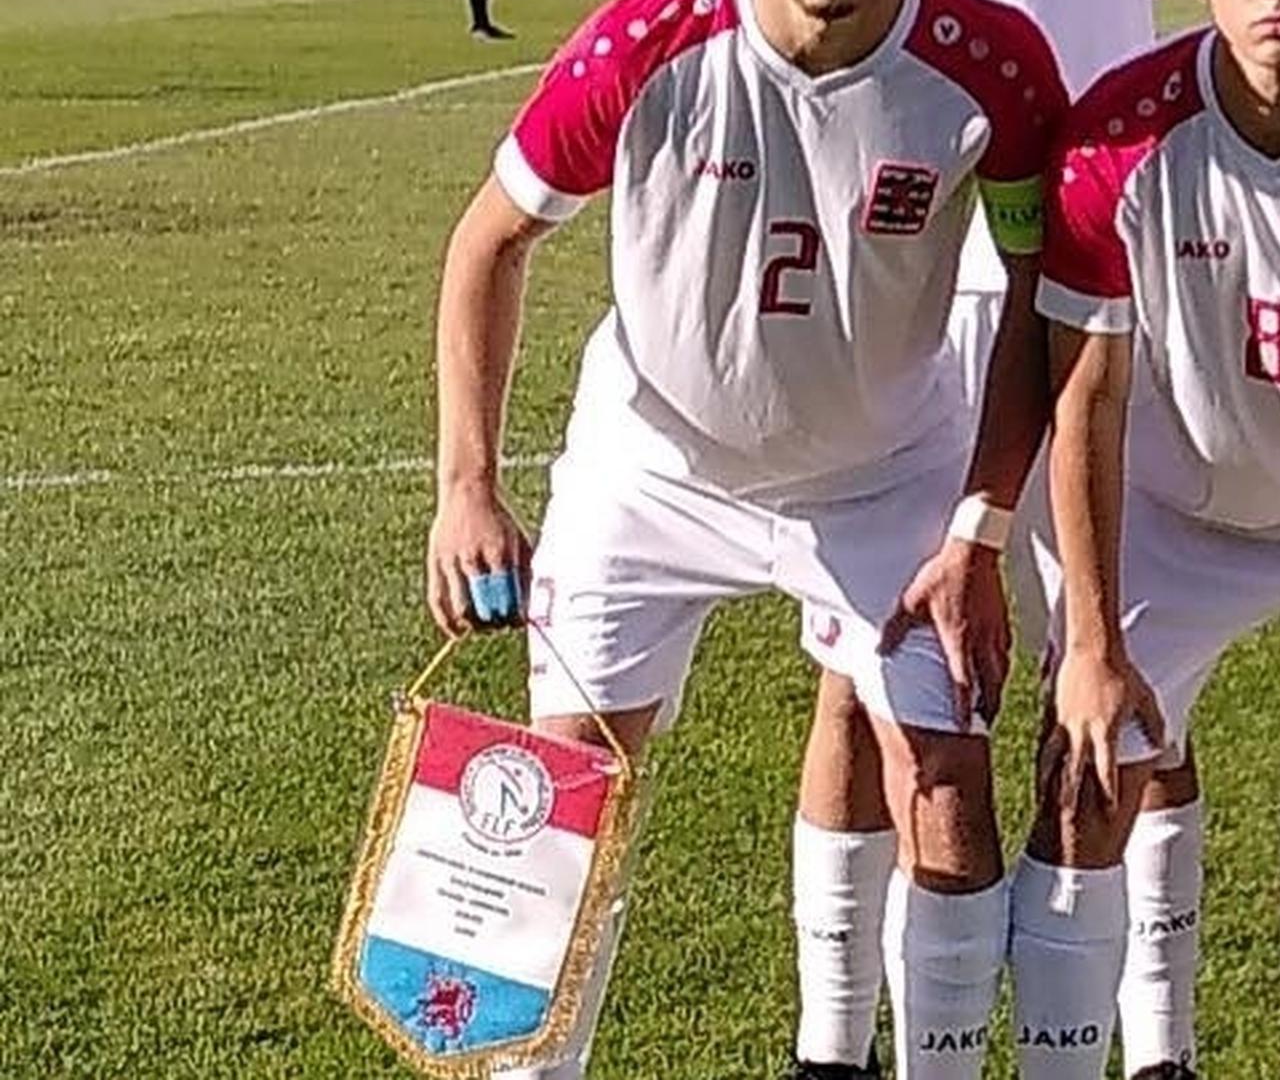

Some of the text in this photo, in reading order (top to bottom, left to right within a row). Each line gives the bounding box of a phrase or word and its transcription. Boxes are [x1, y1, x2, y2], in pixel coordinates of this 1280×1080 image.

[759, 221, 819, 315] 2
[1137, 909, 1196, 936] JAKO
[1017, 1024, 1099, 1048] JAKO
